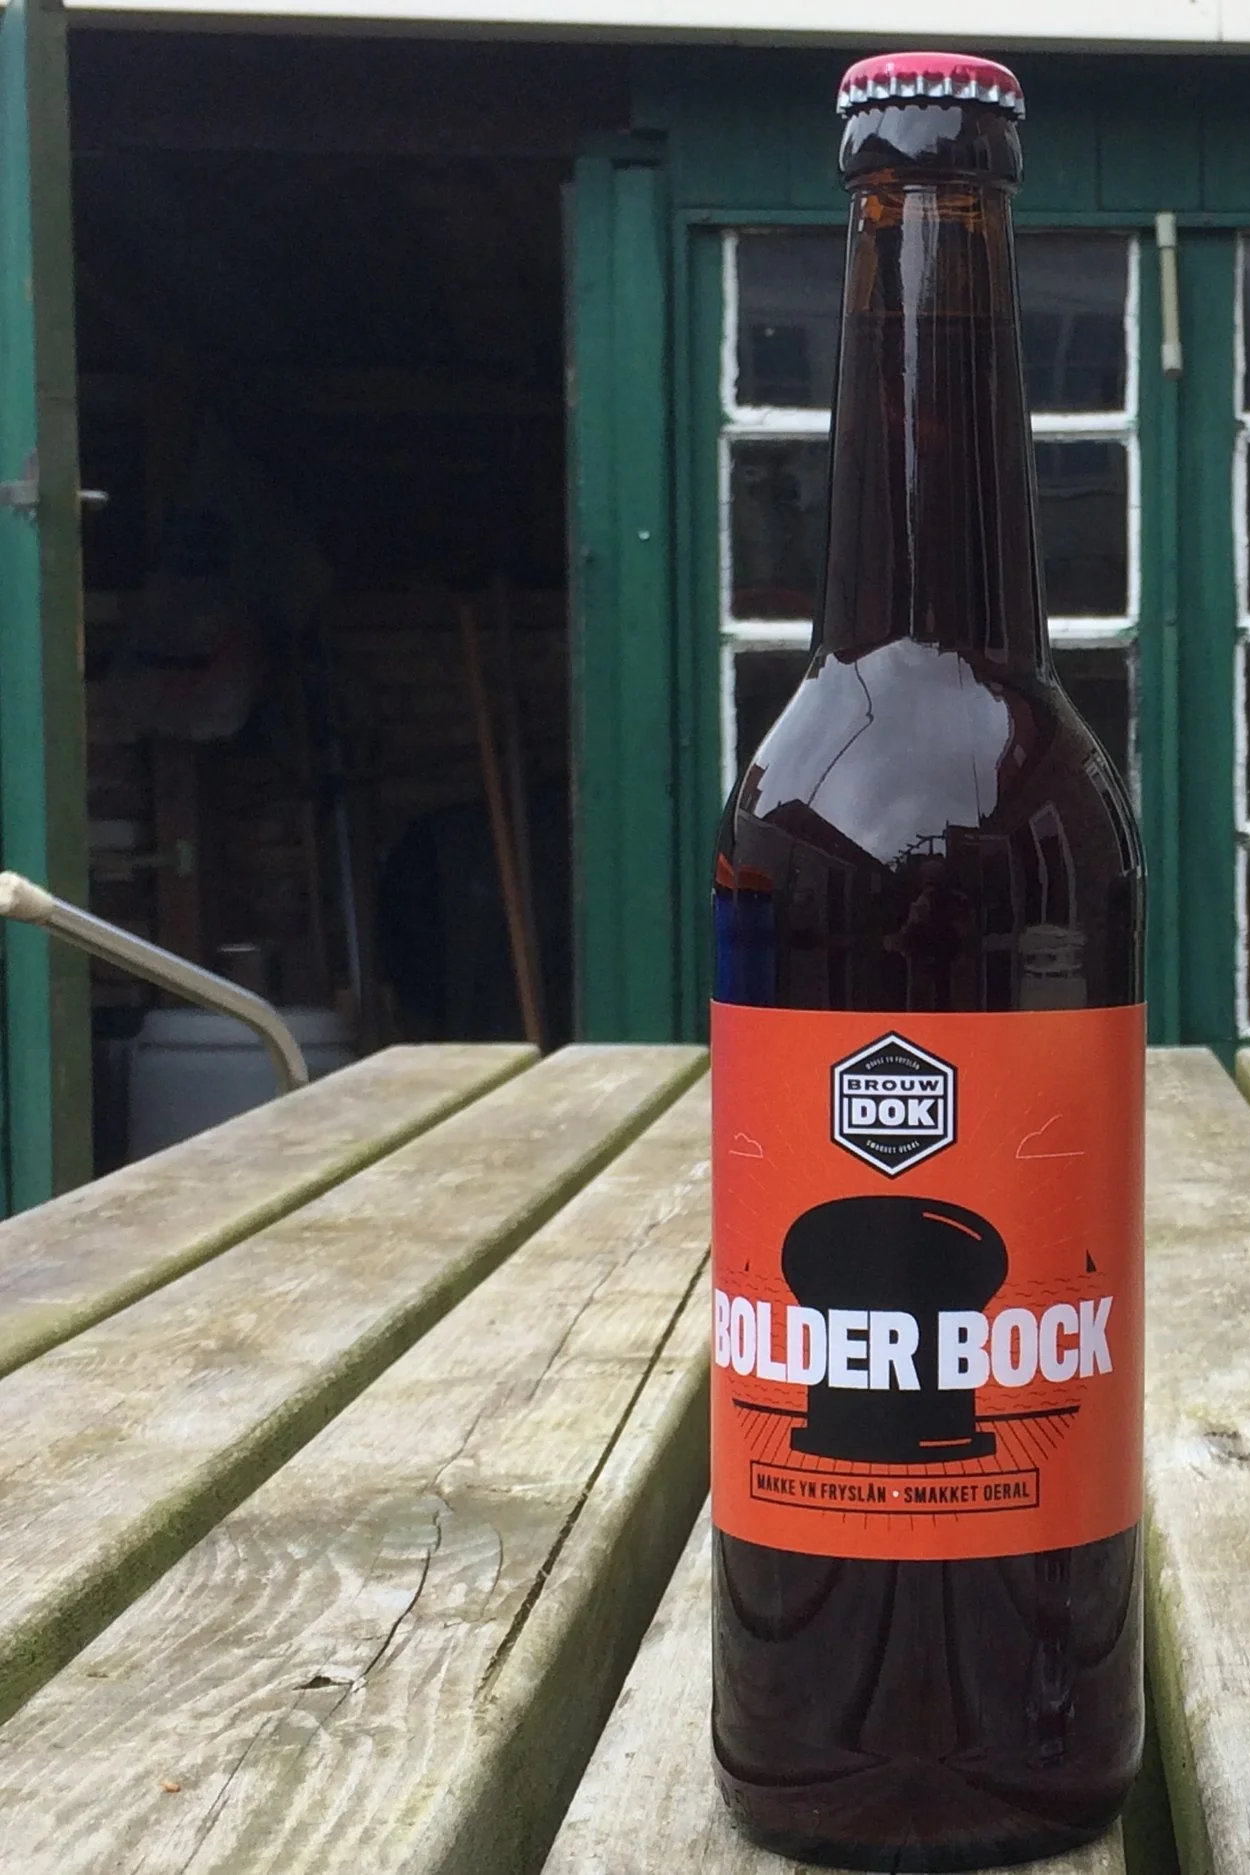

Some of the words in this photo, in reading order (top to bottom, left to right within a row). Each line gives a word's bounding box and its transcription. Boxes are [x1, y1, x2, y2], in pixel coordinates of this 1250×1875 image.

[848, 1079, 939, 1091] BROUW
[851, 1098, 936, 1126] DOK
[714, 1288, 921, 1391] BOLDER
[937, 1296, 1114, 1391] BOCK
[757, 1473, 796, 1496] MAKKE
[800, 1481, 816, 1499] YN
[904, 1485, 978, 1504] SMAKKET
[984, 1481, 1030, 1501] OERAL
